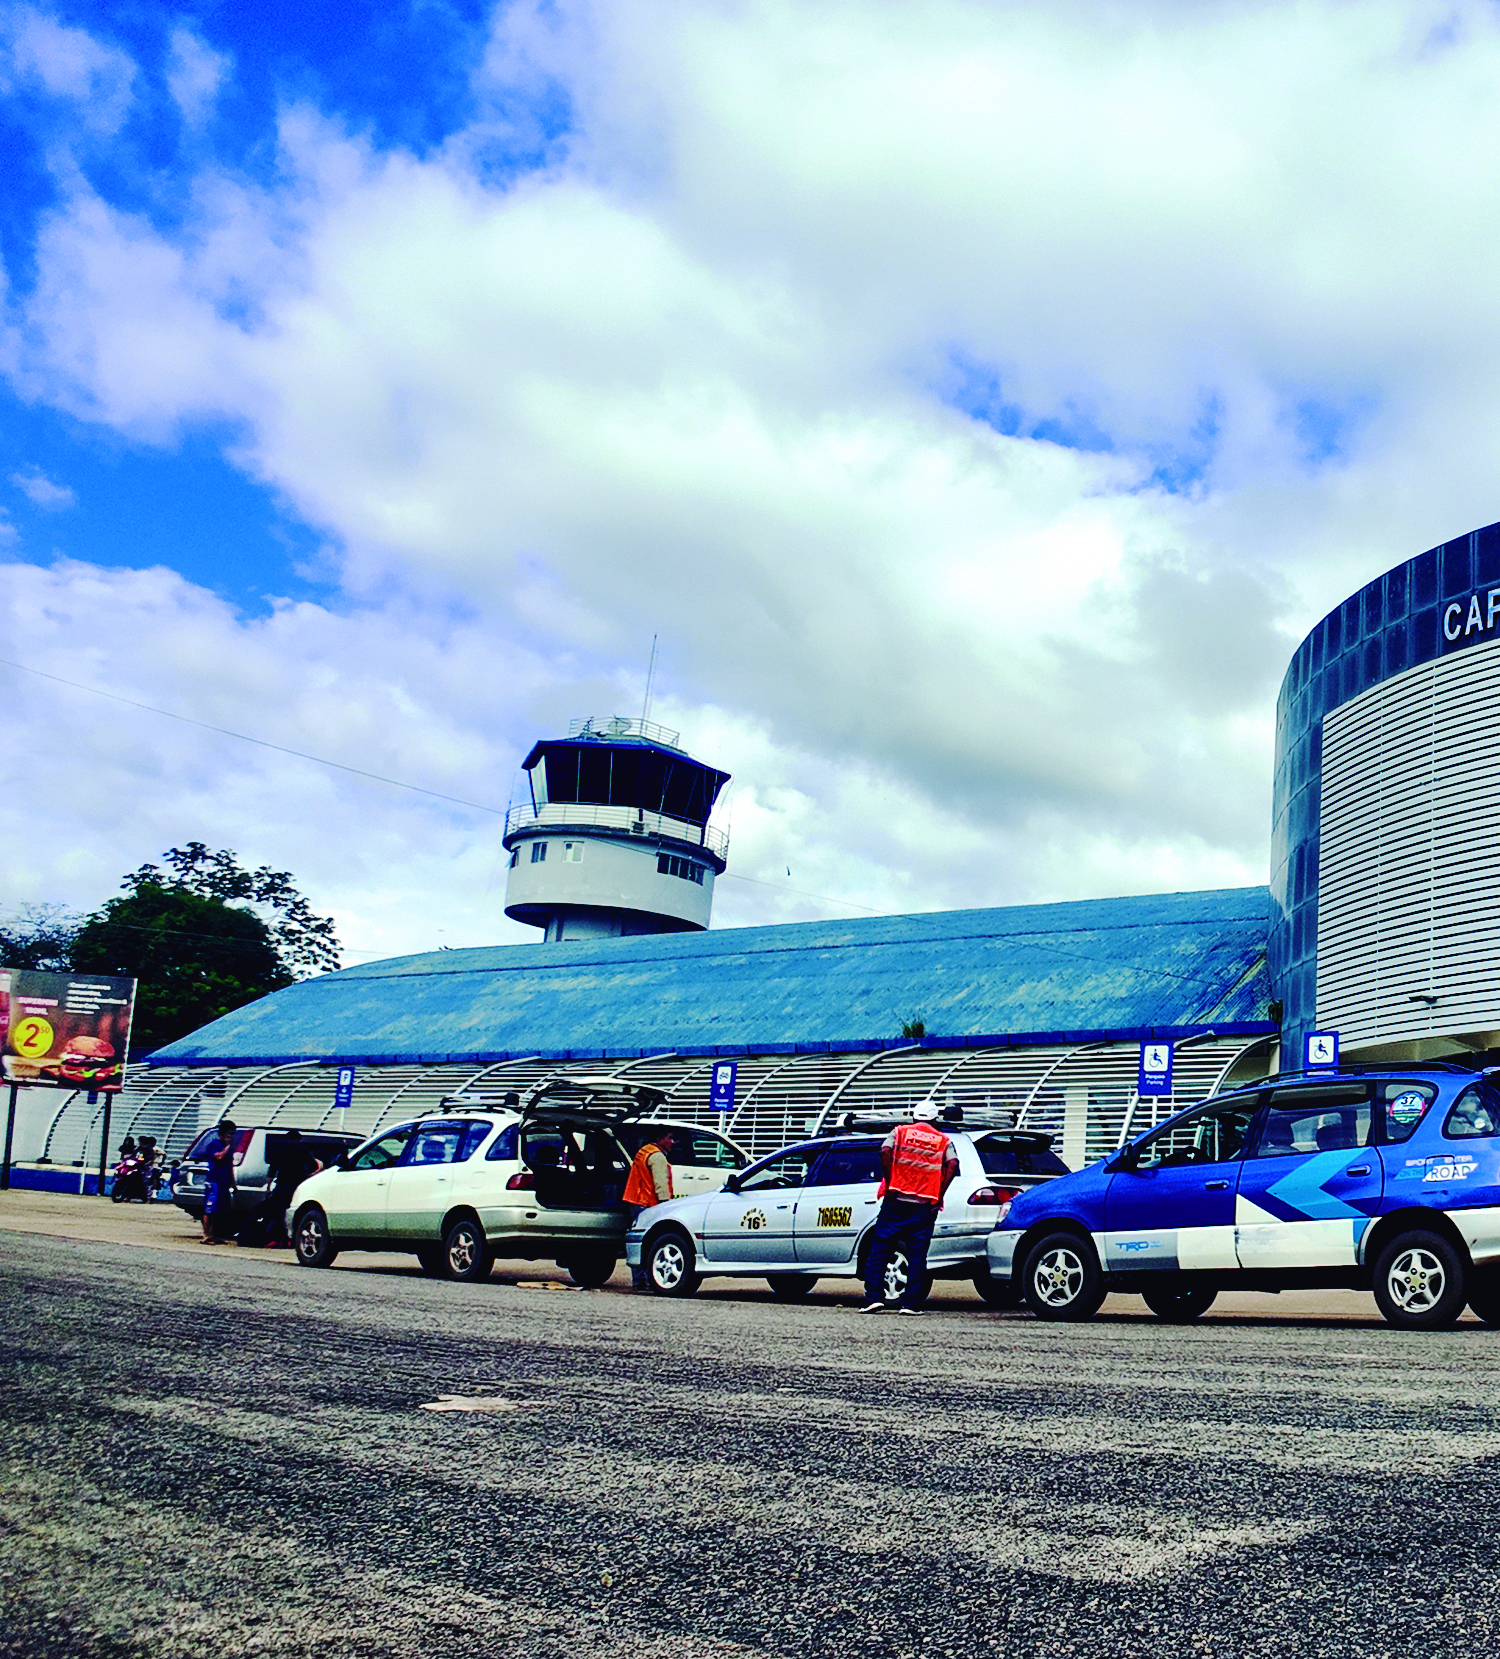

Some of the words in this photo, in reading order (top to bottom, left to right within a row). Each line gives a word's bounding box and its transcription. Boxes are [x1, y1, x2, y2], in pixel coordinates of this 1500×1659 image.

[23, 1023, 40, 1048] 2
[1400, 1096, 1416, 1105] 37
[1430, 1165, 1471, 1179] ROAD
[747, 1216, 761, 1230] 16
